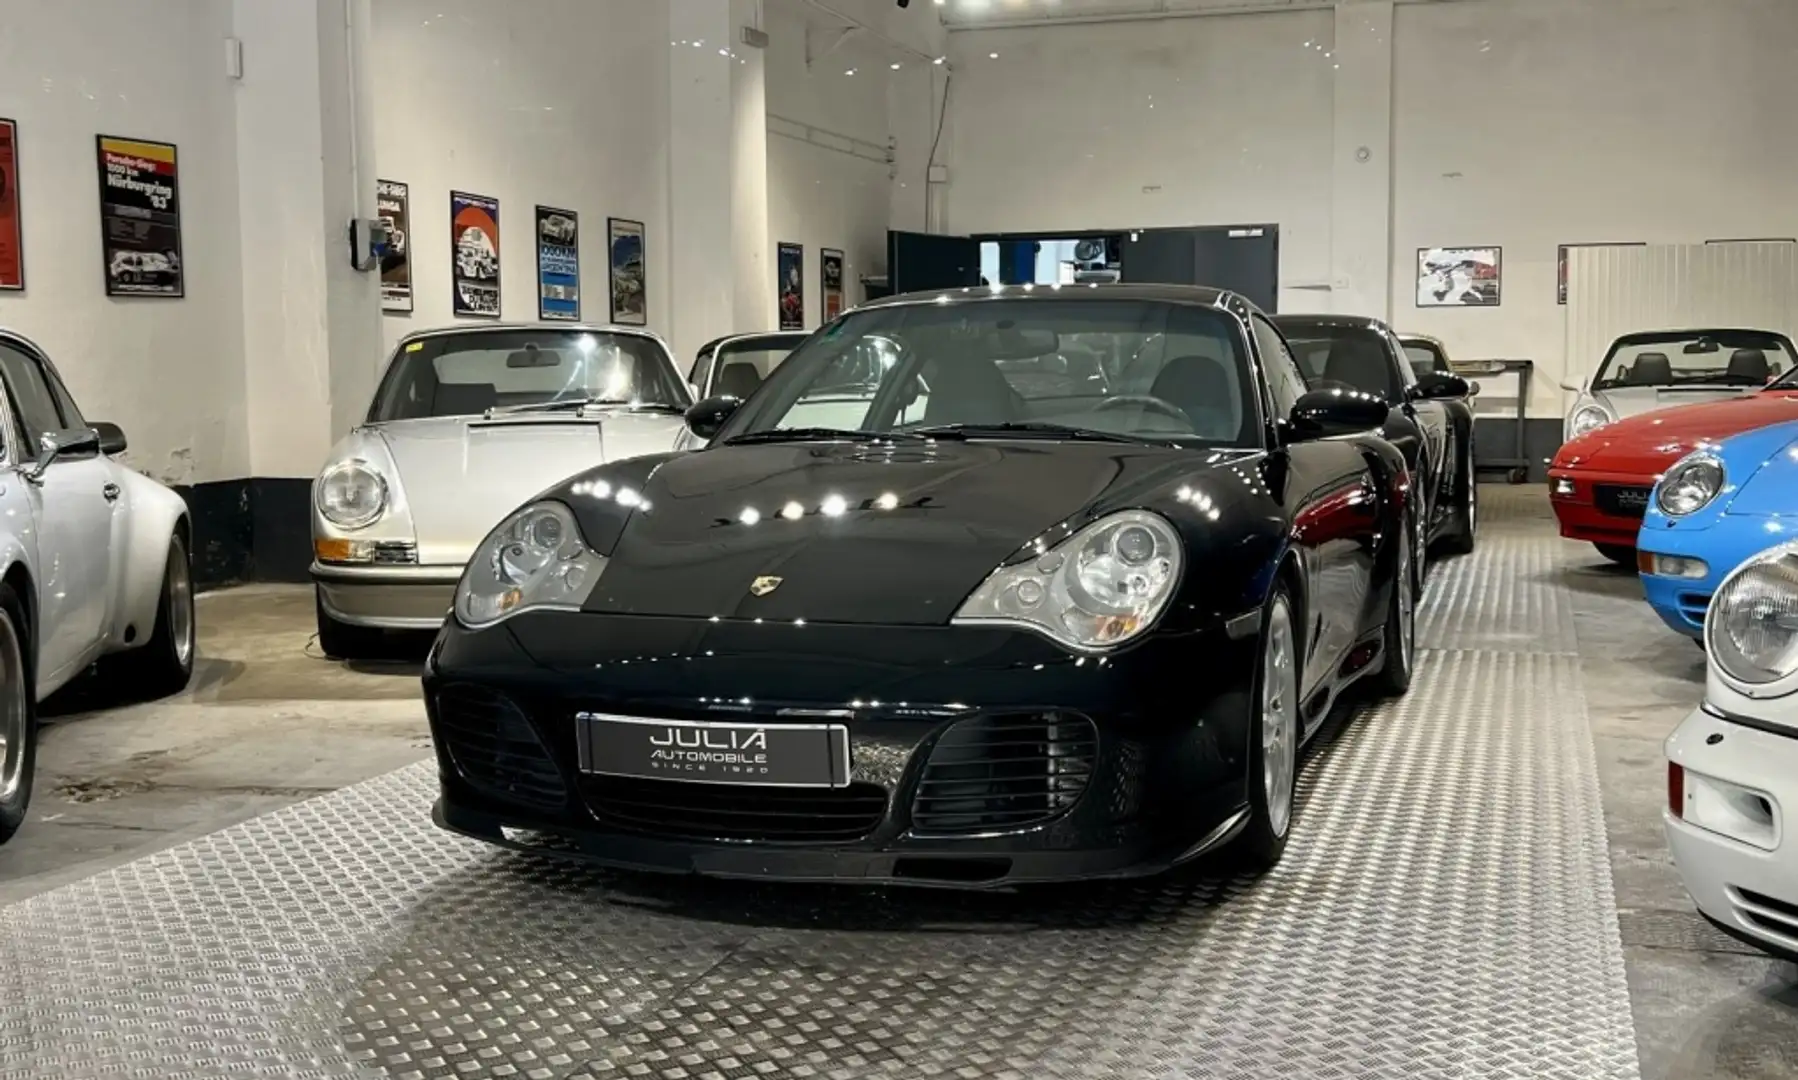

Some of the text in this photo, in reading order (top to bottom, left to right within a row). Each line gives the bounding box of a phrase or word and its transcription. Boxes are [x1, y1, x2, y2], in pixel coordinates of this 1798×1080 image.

[107, 174, 172, 199] Nürburgring
[650, 749, 768, 764] AUTOMOBILE
[651, 761, 706, 771] SINCE
